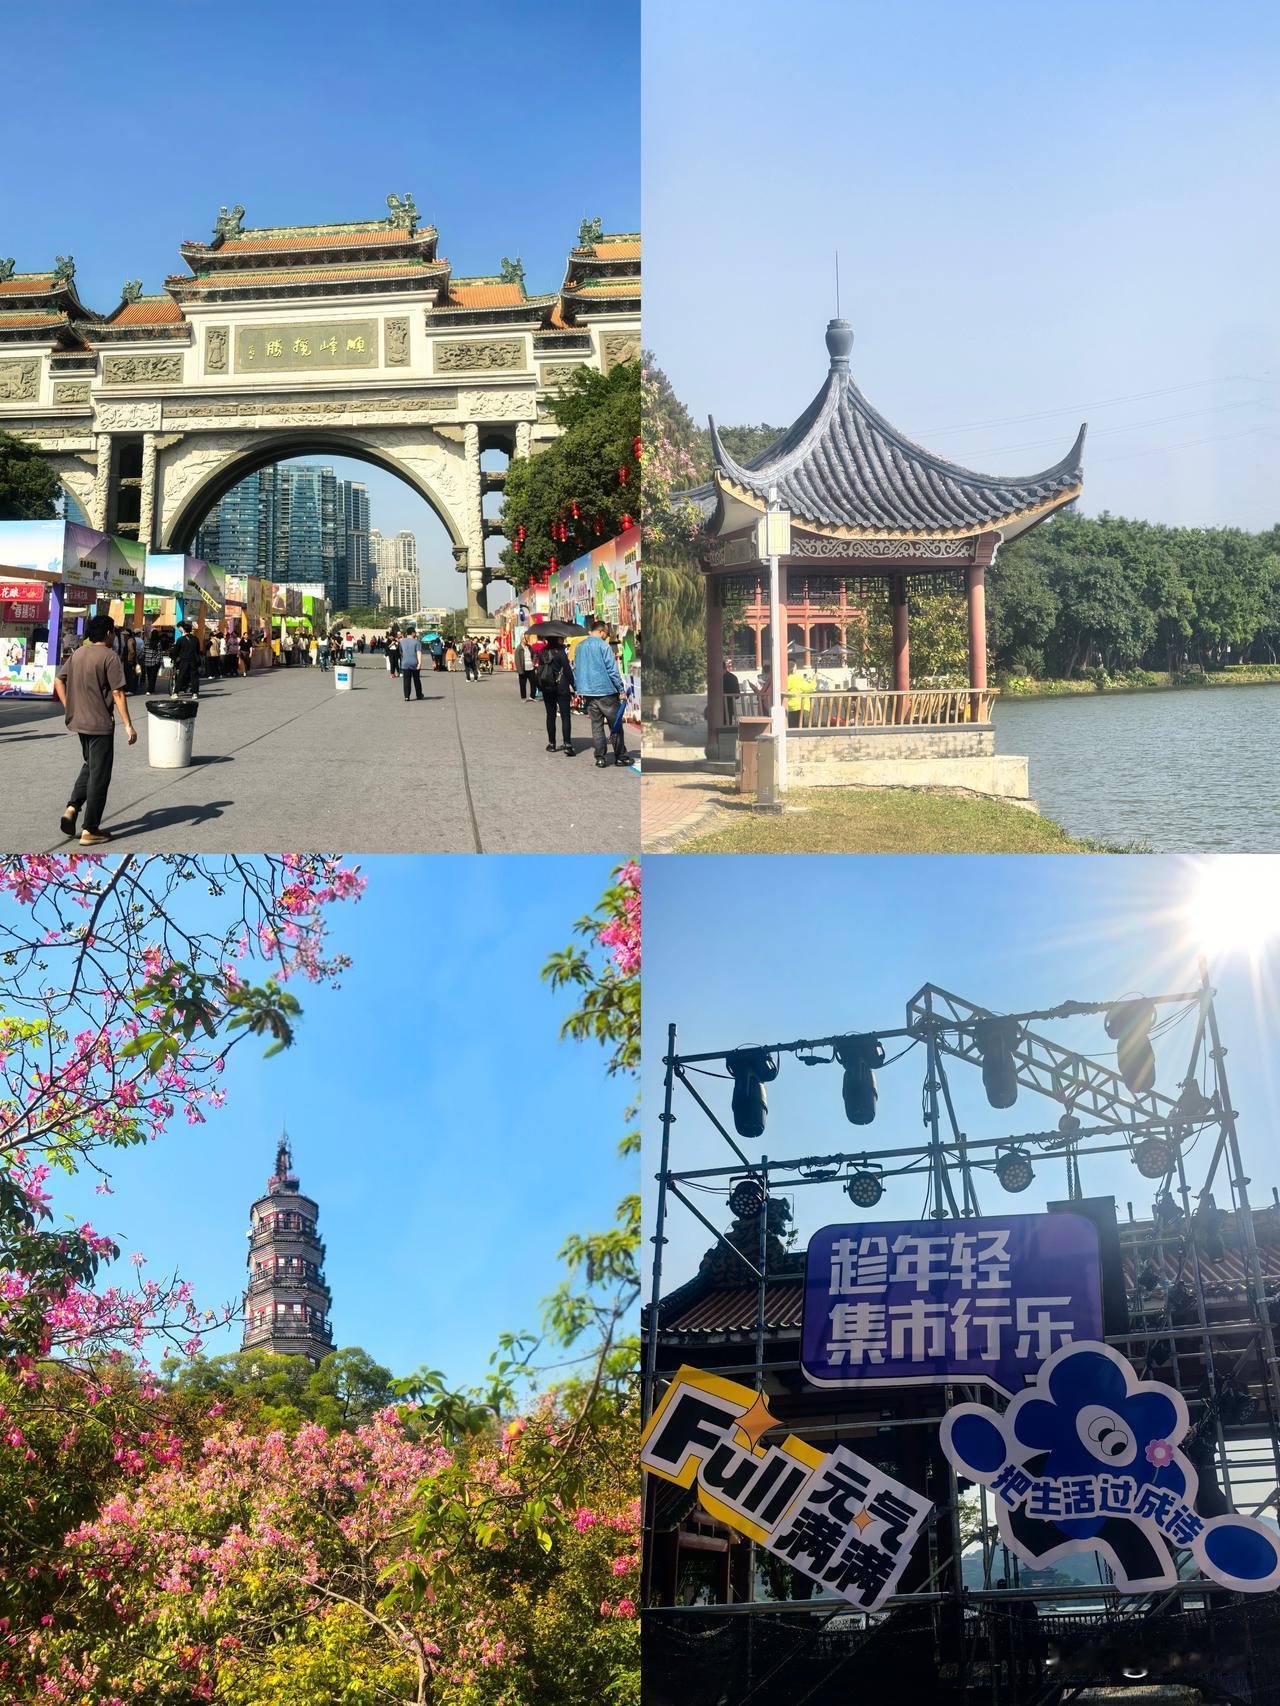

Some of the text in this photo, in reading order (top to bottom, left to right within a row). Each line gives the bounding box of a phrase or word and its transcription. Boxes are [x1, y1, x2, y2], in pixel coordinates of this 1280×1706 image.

[829, 1230, 1012, 1295] 趁年轻
[826, 1296, 1074, 1365] 集市行乐
[650, 1393, 807, 1525] Full
[807, 1461, 919, 1554] 元气
[990, 1464, 1205, 1545] 把生活过成诗
[773, 1507, 897, 1605] 满满
